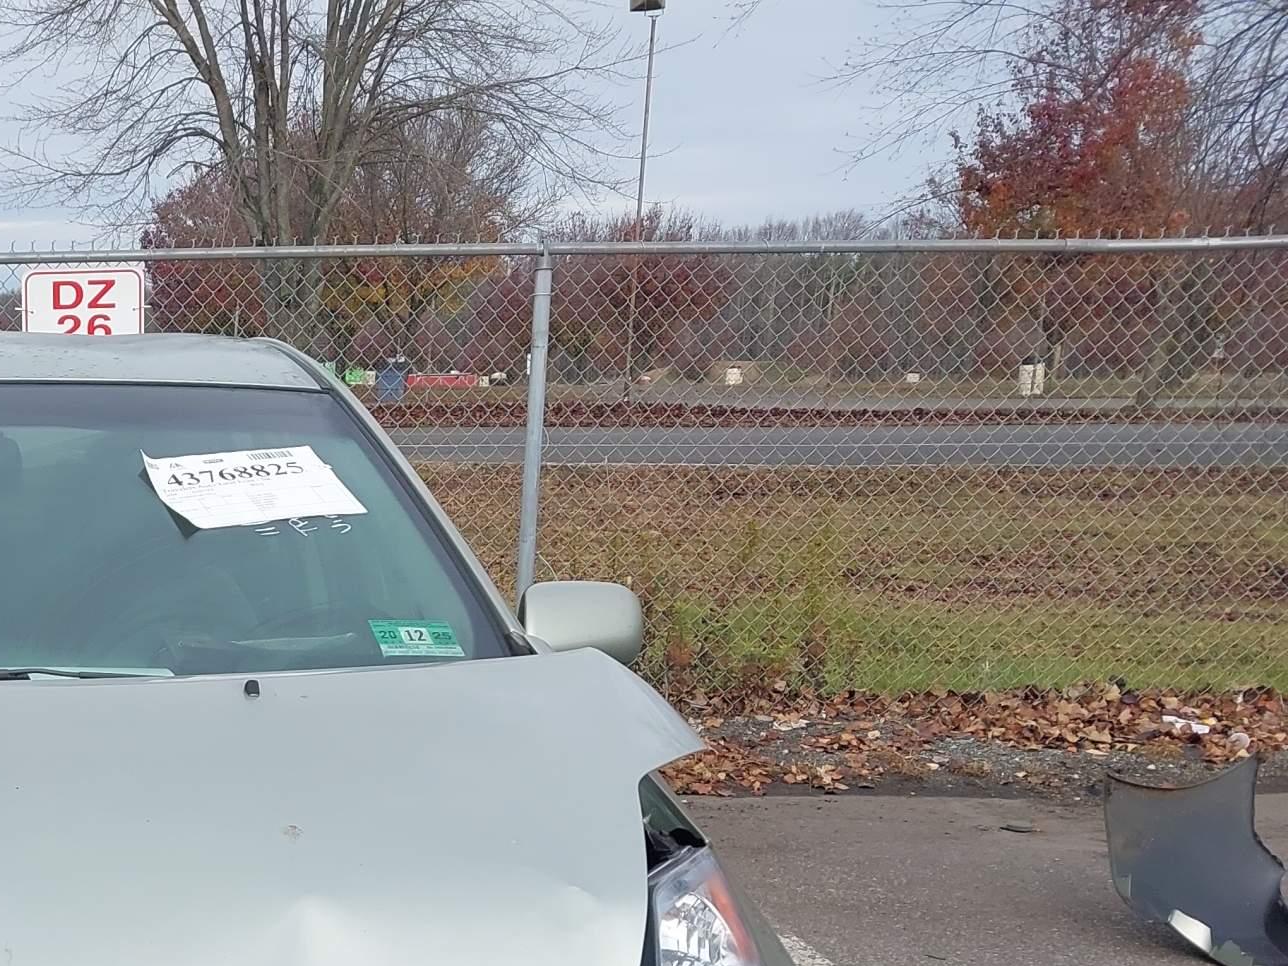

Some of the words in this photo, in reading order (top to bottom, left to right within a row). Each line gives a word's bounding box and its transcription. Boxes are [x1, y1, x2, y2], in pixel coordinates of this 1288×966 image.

[52, 279, 116, 310] DZ
[57, 314, 112, 336] 26
[166, 461, 304, 487] 43768825
[379, 630, 397, 640] 20
[405, 629, 427, 642] 12
[431, 631, 452, 641] 25
